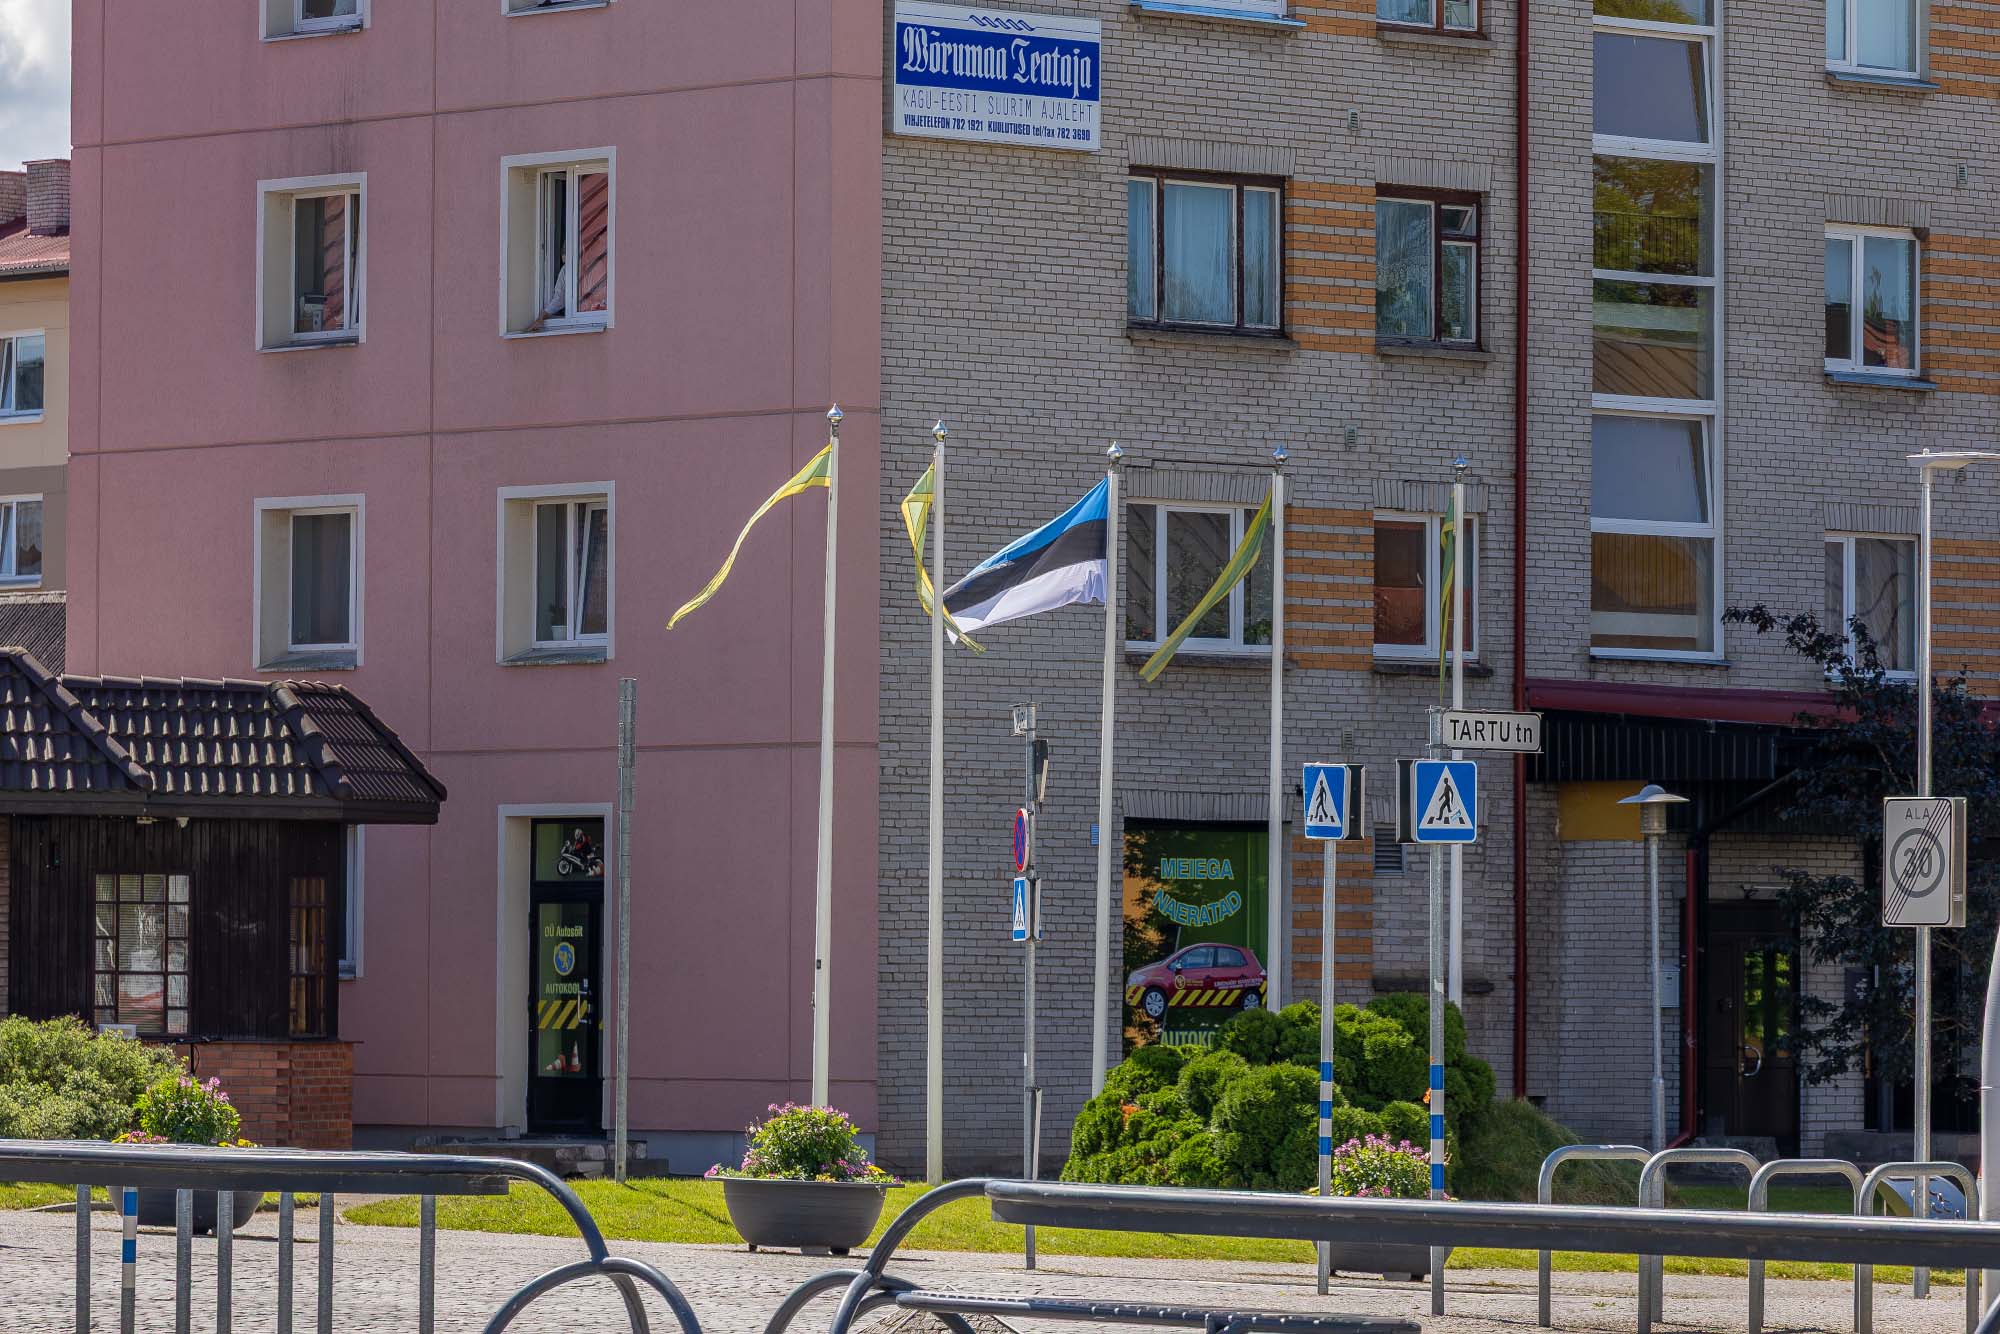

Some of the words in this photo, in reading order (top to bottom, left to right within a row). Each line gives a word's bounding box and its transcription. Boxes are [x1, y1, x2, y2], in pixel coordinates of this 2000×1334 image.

[1011, 38, 1092, 99] Teataja
[903, 88, 977, 113] KAGU-EESTI
[988, 95, 1032, 118] SUURIM
[1041, 99, 1093, 123] AJALEHT
[904, 113, 951, 129] VIHJETELEFON
[952, 117, 966, 130] 782
[967, 119, 983, 132] 1921
[987, 120, 1031, 136] KUULUTUSED
[1032, 124, 1055, 139] tel/fax
[1056, 127, 1071, 140] 782
[1072, 128, 1091, 141] 3690
[1449, 719, 1511, 743] TARTU
[1515, 723, 1533, 744] tn
[1904, 807, 1930, 820] ALA
[1160, 857, 1235, 880] MEIEGA
[1152, 888, 1242, 927] NAERATAD
